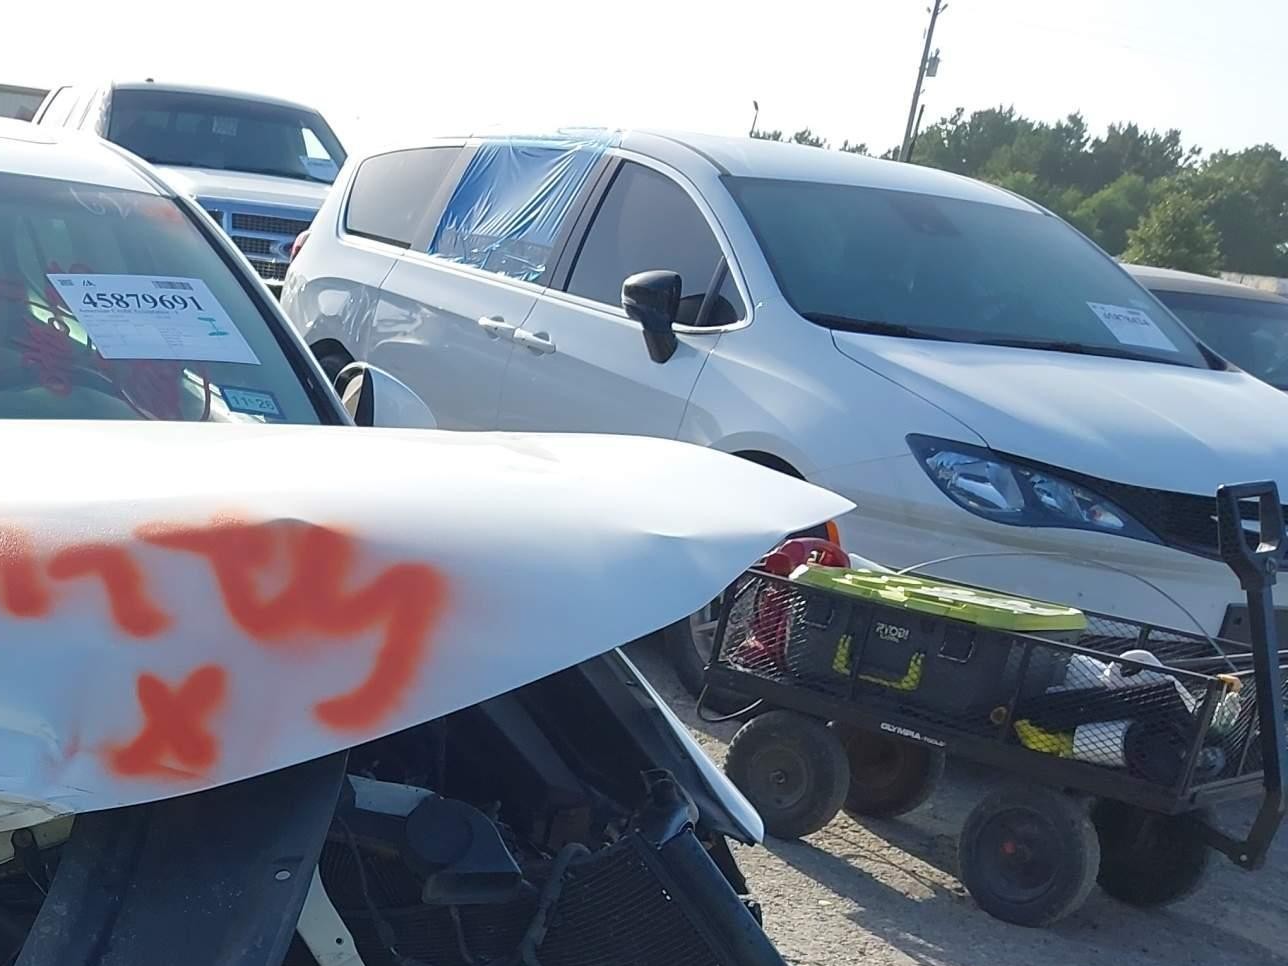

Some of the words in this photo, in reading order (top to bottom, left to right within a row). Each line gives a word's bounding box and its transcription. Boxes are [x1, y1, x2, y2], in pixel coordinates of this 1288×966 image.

[82, 292, 204, 311] 45879691
[875, 622, 910, 640] RYOBI
[880, 722, 921, 740] OLYMPIA
